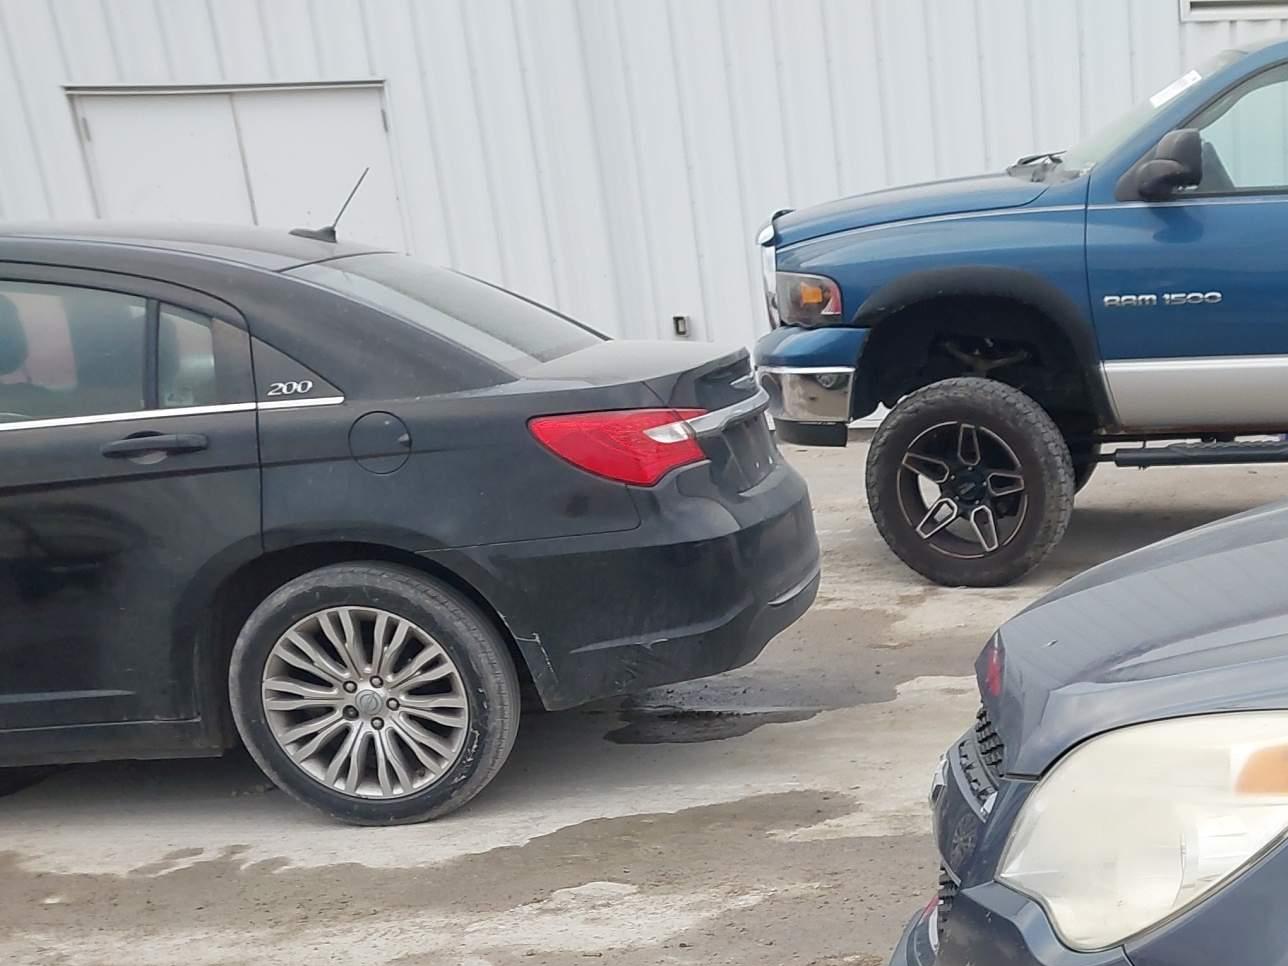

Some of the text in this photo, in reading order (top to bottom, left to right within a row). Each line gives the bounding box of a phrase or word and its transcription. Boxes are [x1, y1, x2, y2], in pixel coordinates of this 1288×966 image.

[1103, 291, 1223, 307] RAM 1500
[266, 380, 313, 396] 200
